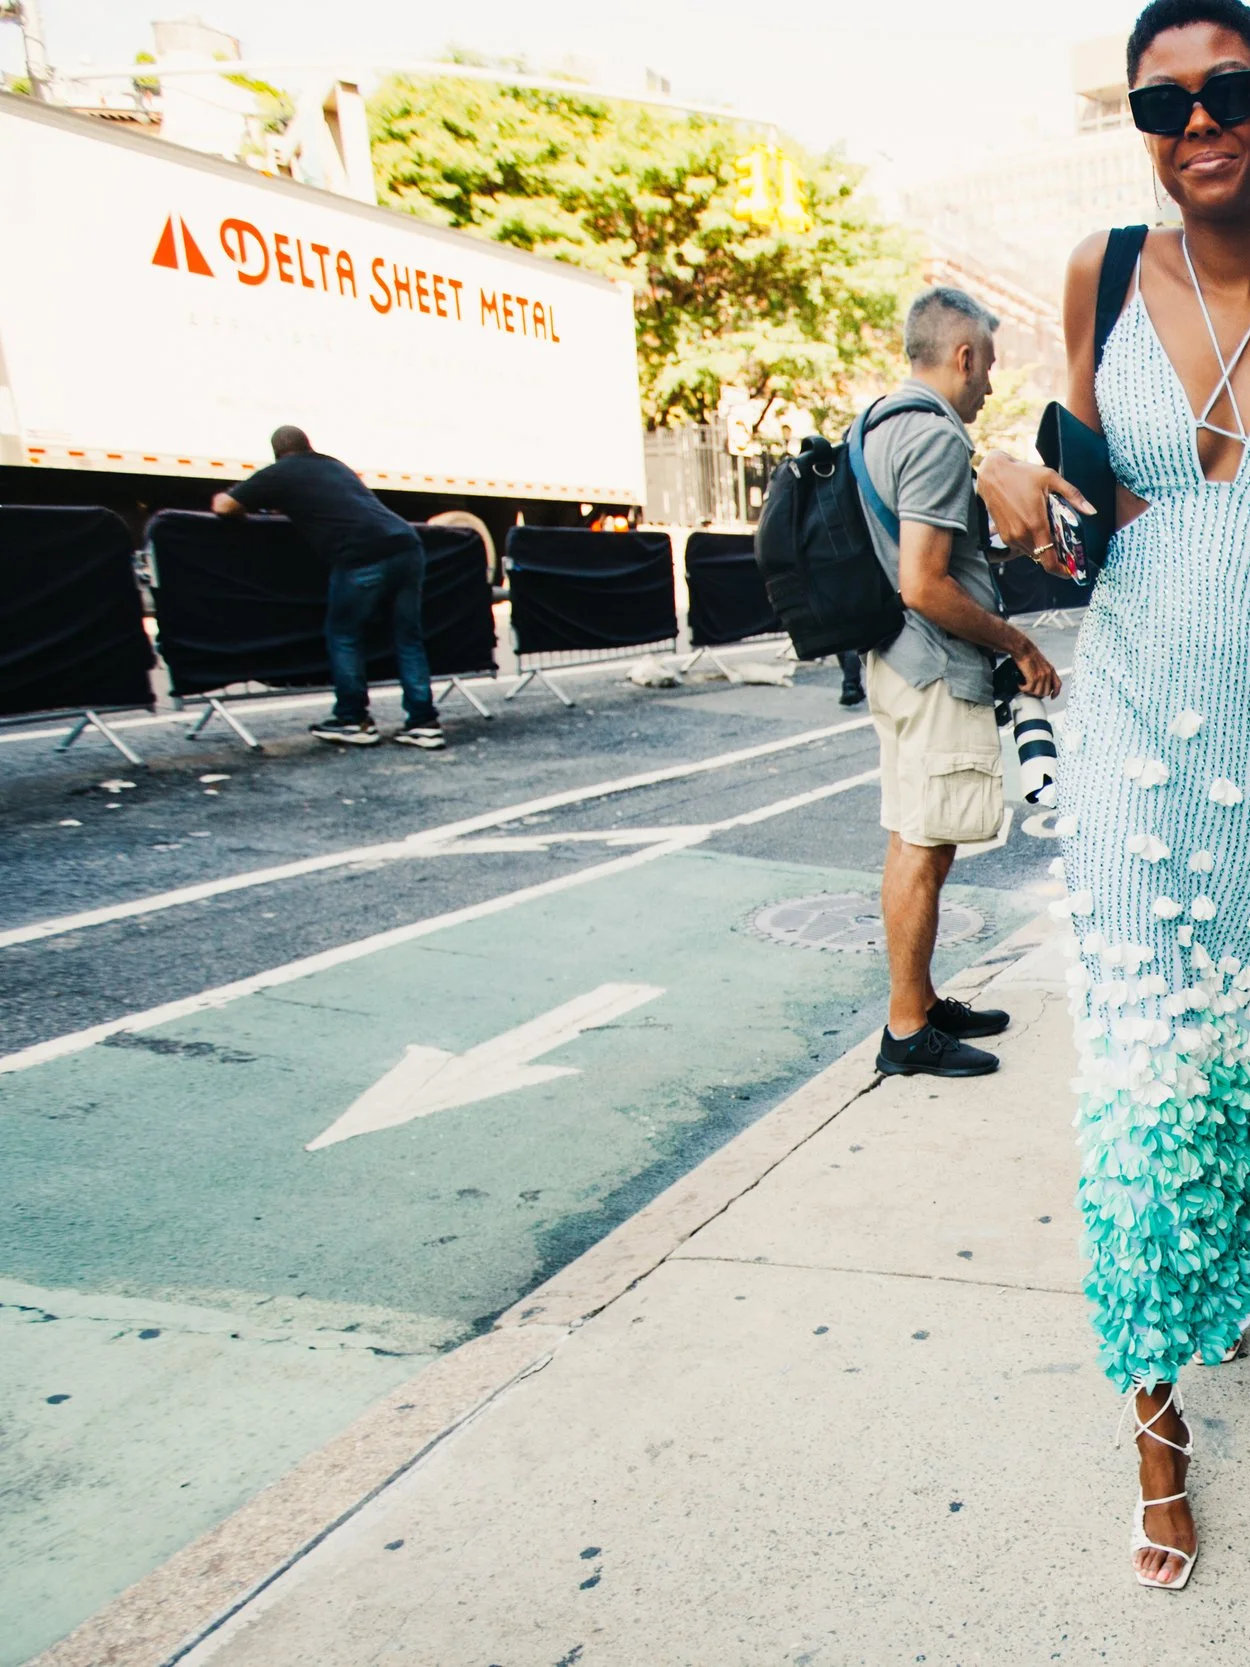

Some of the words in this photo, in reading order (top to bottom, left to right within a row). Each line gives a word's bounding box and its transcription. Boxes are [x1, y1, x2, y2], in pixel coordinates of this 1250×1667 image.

[219, 217, 357, 298] DELTA
[369, 257, 463, 321] SHEET
[480, 287, 560, 343] METAL
